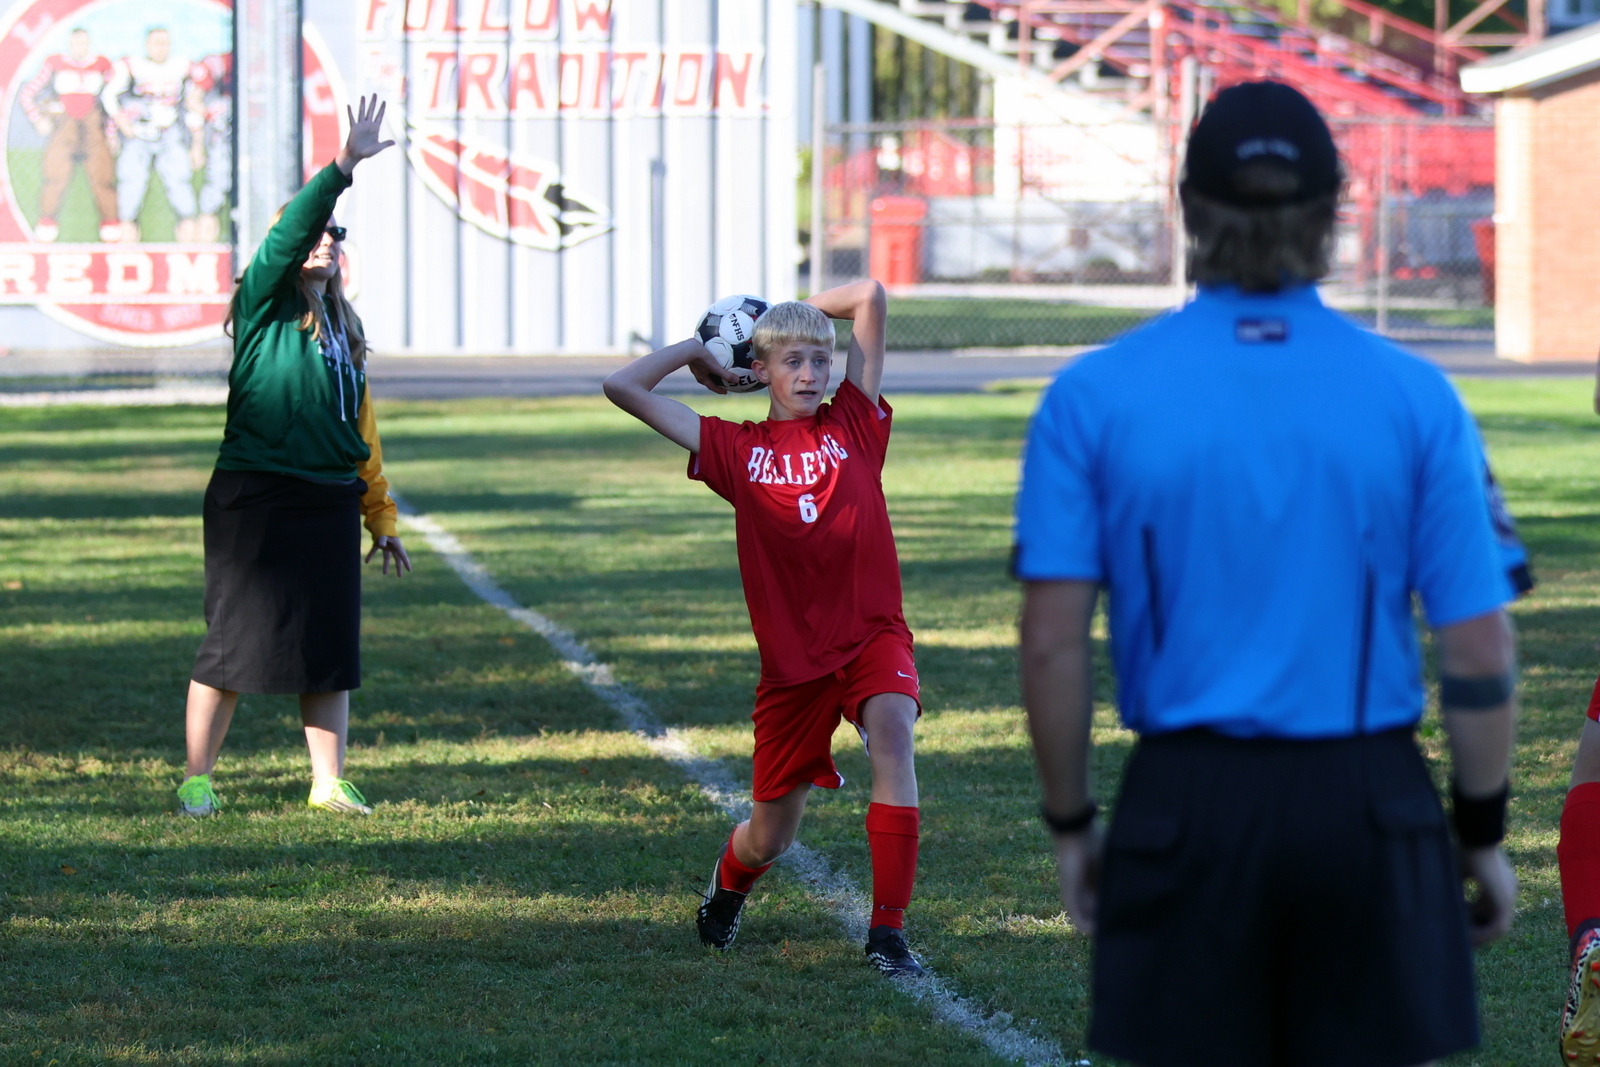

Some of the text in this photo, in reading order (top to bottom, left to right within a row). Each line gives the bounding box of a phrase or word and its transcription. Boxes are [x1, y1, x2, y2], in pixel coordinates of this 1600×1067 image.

[0, 252, 220, 295] REDM
[730, 318, 745, 341] NFHS
[798, 493, 818, 523] 6
